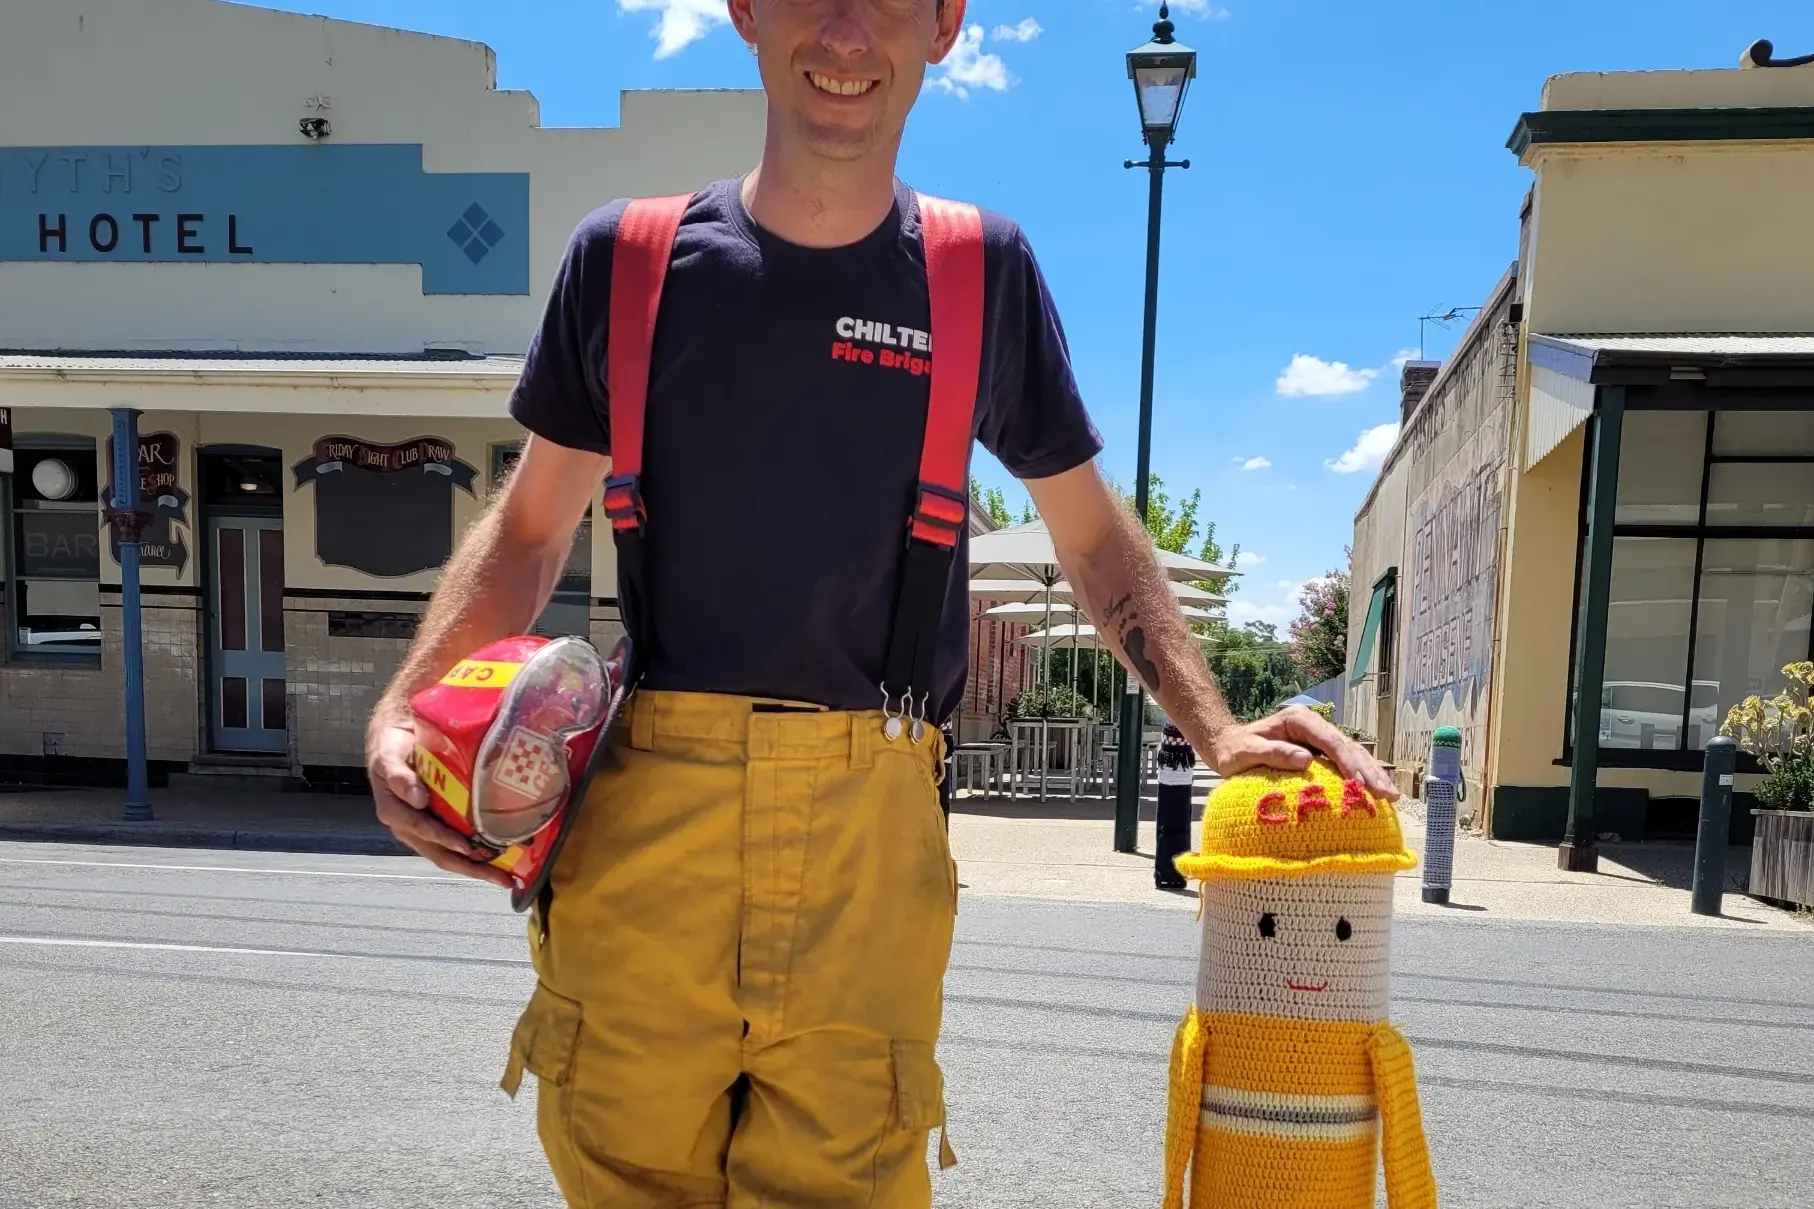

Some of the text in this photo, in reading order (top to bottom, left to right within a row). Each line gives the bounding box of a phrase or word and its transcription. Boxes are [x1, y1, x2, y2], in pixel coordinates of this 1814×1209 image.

[0, 146, 183, 194] YTH'S
[38, 213, 254, 255] HOTEL
[836, 316, 932, 353] CHILTE
[831, 341, 874, 364] Fire
[137, 443, 175, 465] AR
[26, 533, 96, 557] BAR
